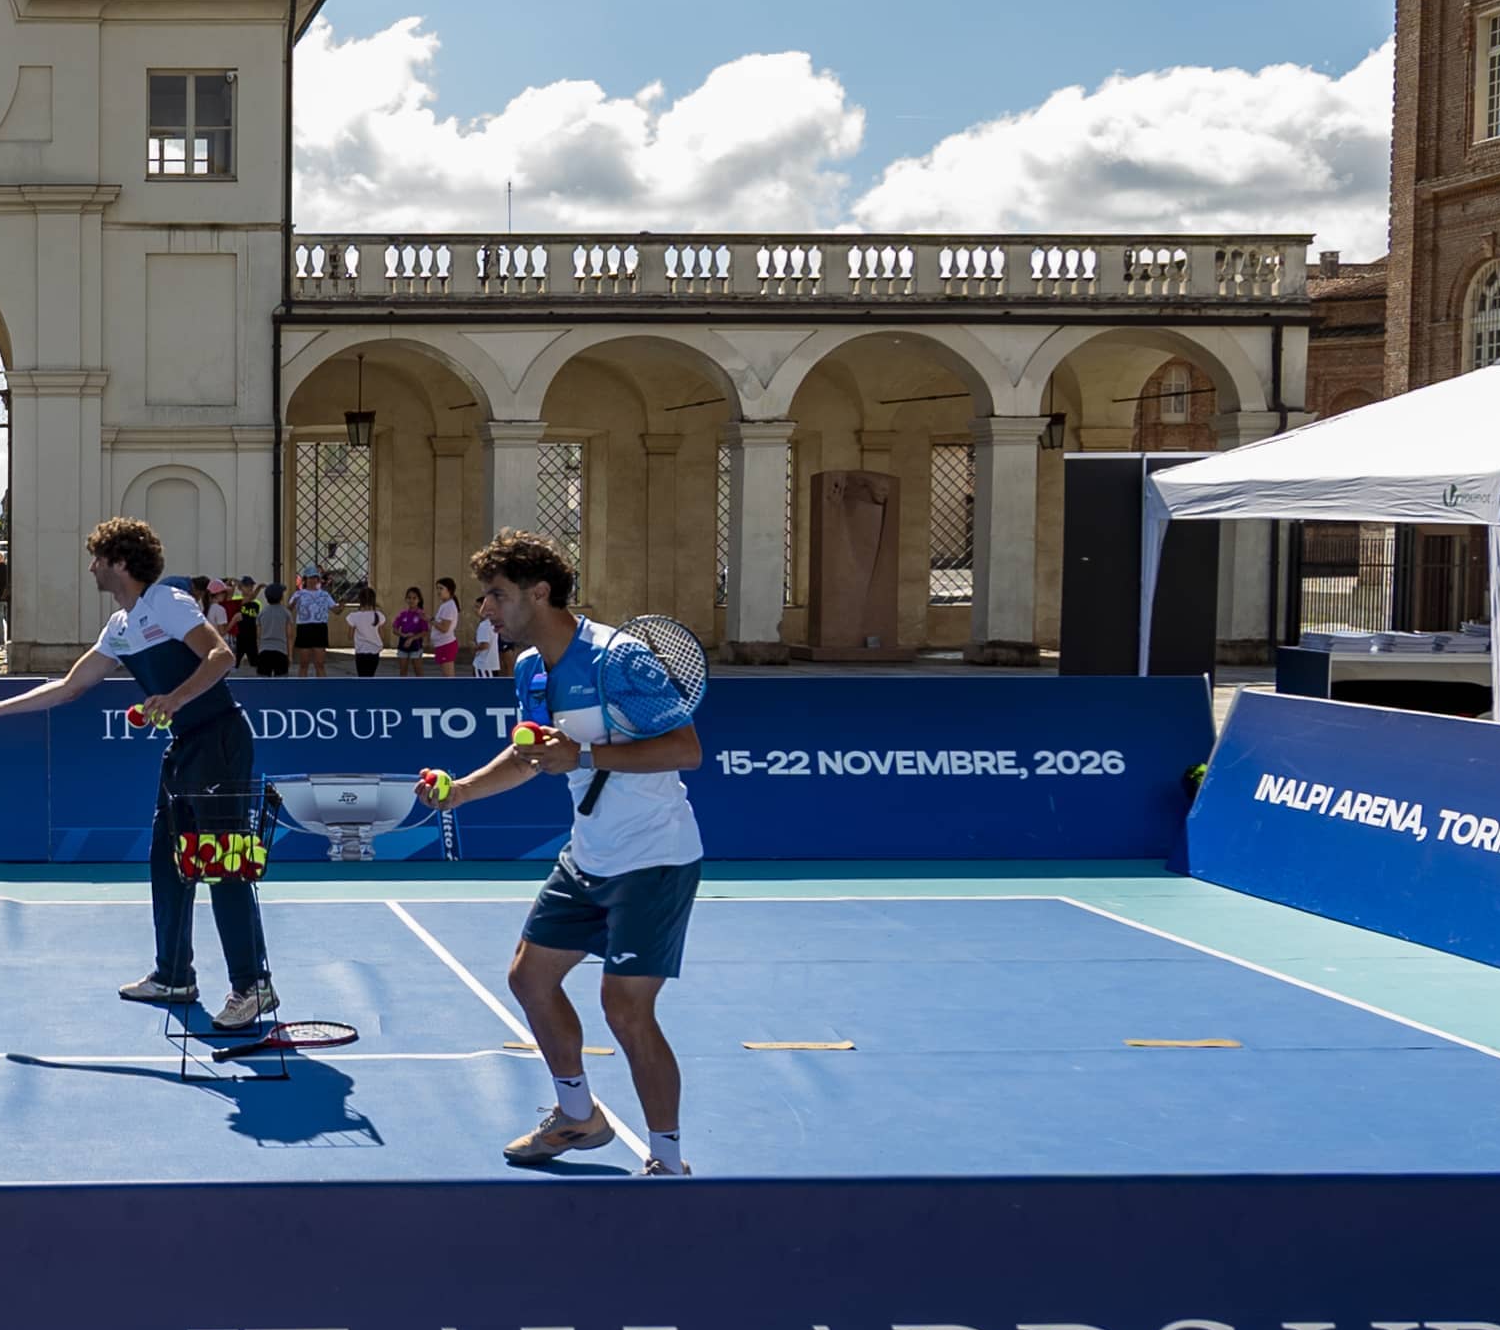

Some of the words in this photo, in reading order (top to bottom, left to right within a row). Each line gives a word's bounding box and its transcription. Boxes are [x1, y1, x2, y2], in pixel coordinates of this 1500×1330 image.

[349, 709, 402, 739] UP
[412, 708, 476, 739] TO
[716, 750, 811, 775] 15-22
[818, 750, 1029, 779] NOVEMBRE,
[1033, 750, 1126, 775] 2026
[1254, 773, 1335, 815] INALPI
[1328, 789, 1428, 842] ARENA,
